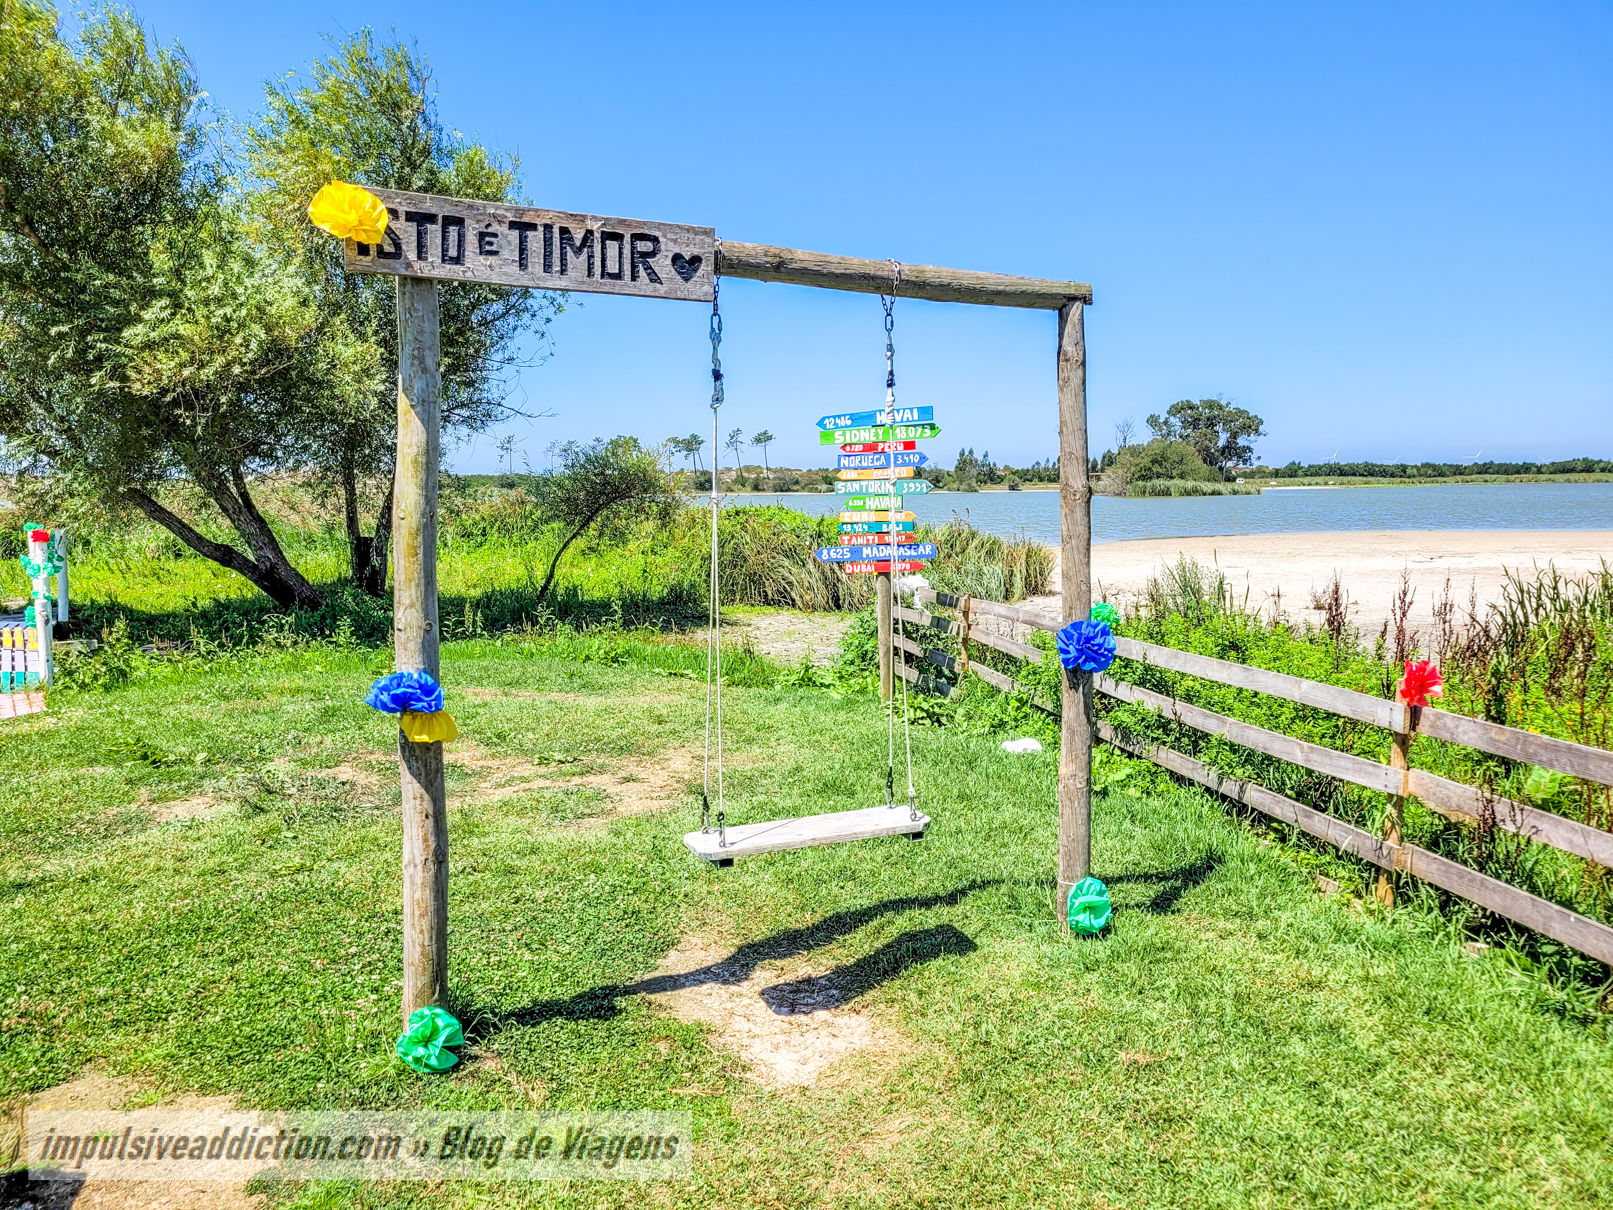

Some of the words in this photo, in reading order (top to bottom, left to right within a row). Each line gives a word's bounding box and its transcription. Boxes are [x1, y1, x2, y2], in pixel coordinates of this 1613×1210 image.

[356, 207, 466, 266] STO
[508, 219, 664, 285] TIMOR
[876, 408, 919, 424] HVAI
[834, 428, 884, 443] SIDNEY
[878, 442, 904, 452] PERU
[840, 455, 886, 467] NORUEGA
[896, 454, 920, 464] 3.410
[844, 512, 876, 522] CUBA
[882, 523, 903, 532] BALI
[841, 535, 878, 544] TAHITI
[845, 564, 875, 573] DUBAI
